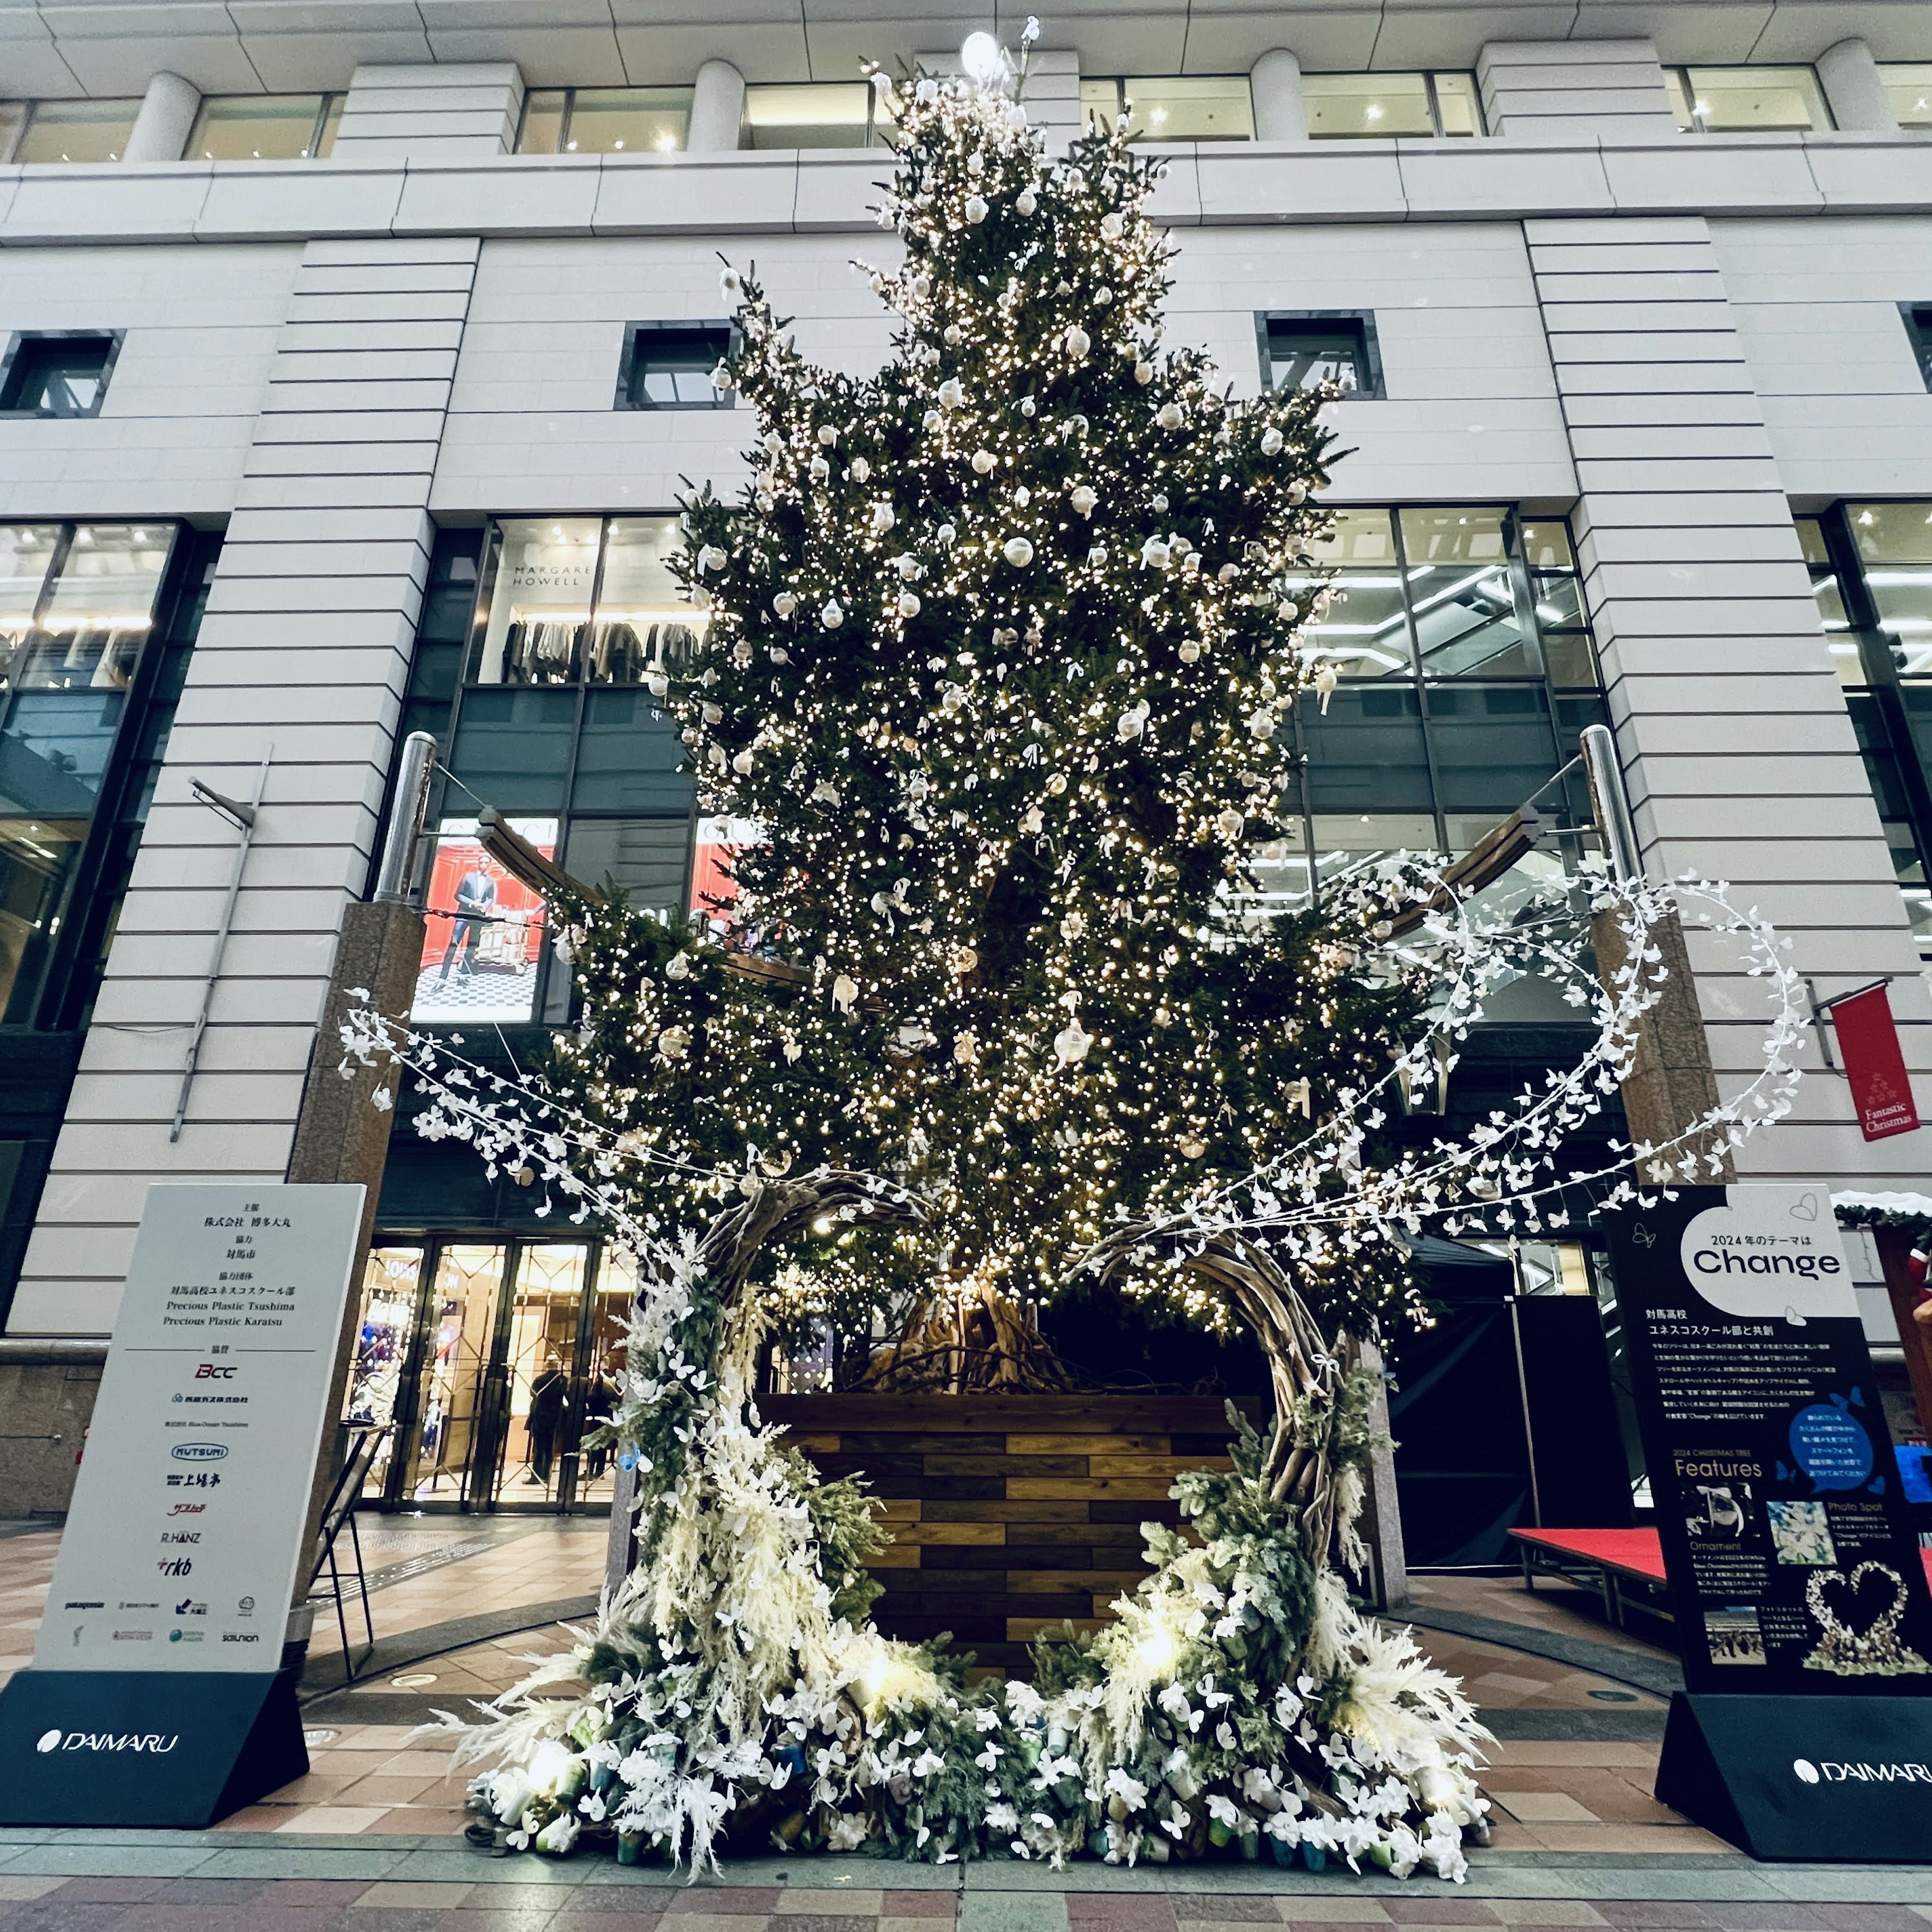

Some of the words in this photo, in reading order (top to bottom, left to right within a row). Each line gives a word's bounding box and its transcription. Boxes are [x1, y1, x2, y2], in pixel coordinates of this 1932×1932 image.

[515, 567, 591, 575] MARGARE
[1865, 1102, 1907, 1120] Fantastic
[1866, 1115, 1911, 1133] Christmas
[204, 1217, 244, 1227] 株式会社
[251, 1217, 291, 1228] 博多大丸
[1711, 1235, 1812, 1246] 2024年のテーマは
[226, 1249, 256, 1259] 対馬市
[1694, 1249, 1841, 1281] Change
[171, 1286, 296, 1296] 対馬高校ユネスコスクール部
[167, 1301, 208, 1311] Precious
[212, 1302, 245, 1311] Plastic
[249, 1302, 295, 1311] Tsushima
[1645, 1309, 1688, 1320] 対馬高校
[163, 1316, 205, 1326] Precious
[208, 1317, 240, 1326] Plastic
[245, 1317, 282, 1326] Karatsu
[1675, 1459, 1762, 1477] Features
[1828, 1502, 1858, 1511] Photo
[1860, 1502, 1883, 1512] Spot
[1690, 1541, 1742, 1551] Ornament
[62, 1733, 178, 1752] DAIMARU
